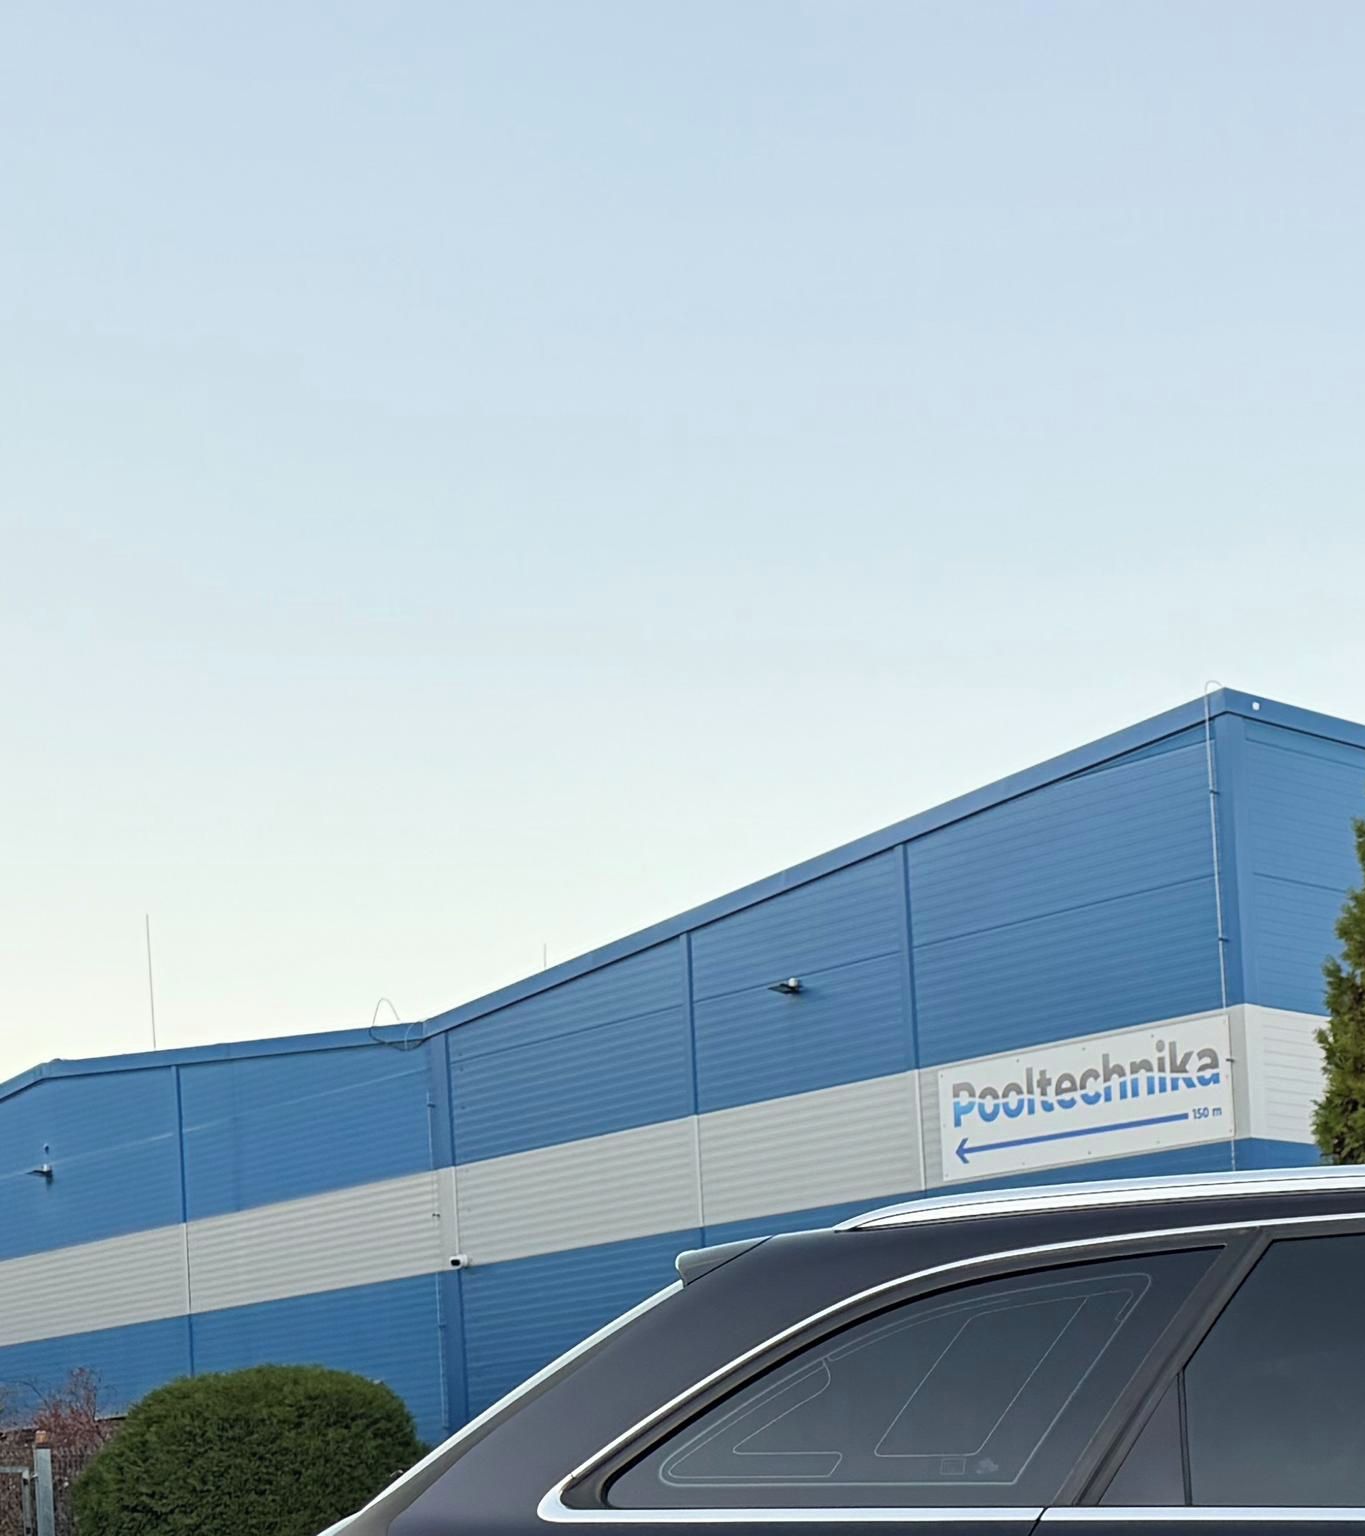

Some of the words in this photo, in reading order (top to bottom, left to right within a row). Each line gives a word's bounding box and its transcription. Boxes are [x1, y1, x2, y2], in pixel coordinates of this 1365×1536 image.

[952, 1040, 1221, 1128] Pooltechnika
[1192, 1107, 1209, 1120] 150
[1212, 1107, 1222, 1117] m
